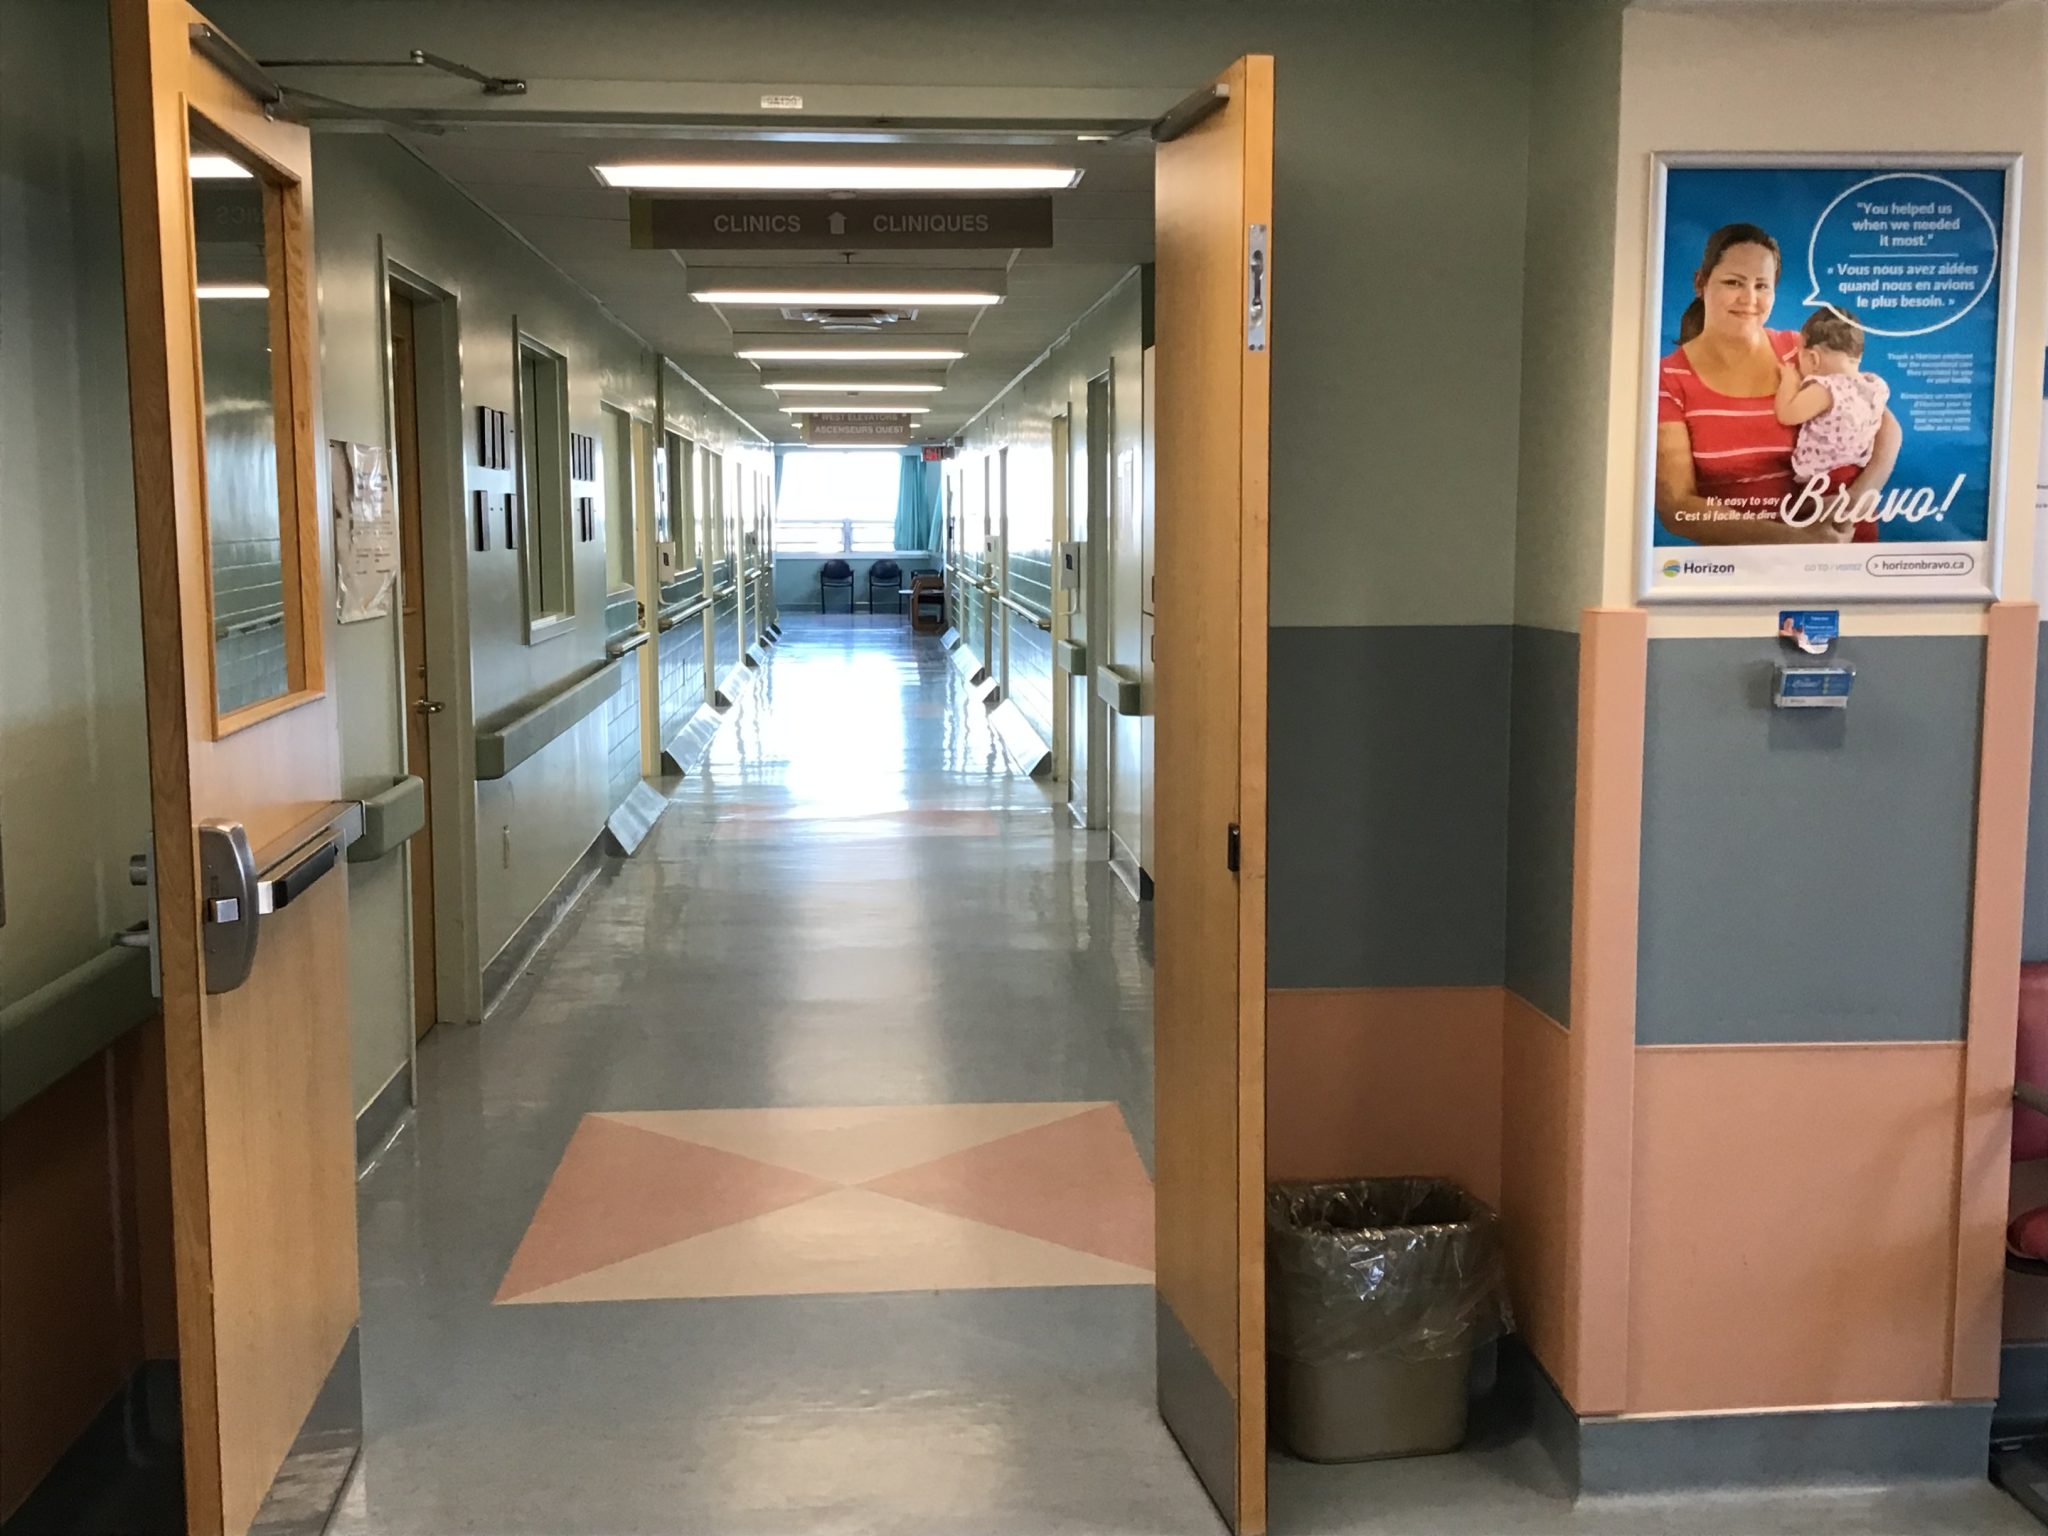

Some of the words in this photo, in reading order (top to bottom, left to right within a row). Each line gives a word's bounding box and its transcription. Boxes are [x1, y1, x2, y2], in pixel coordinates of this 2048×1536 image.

[1891, 202, 1935, 217] helped
[1937, 205, 1953, 215] us
[713, 214, 801, 233] CLINICS
[873, 214, 989, 233] CLINIQUES
[1852, 218, 1888, 231] when
[1891, 221, 1911, 231] we
[1913, 217, 1961, 231] needed
[1879, 234, 1889, 247] it
[1837, 263, 1870, 276] Vous
[1872, 266, 1904, 276] nous
[1906, 265, 1935, 275] avez
[1937, 262, 1979, 275] aidées
[1838, 279, 1880, 294] quand
[1882, 281, 1913, 291] nous
[1915, 281, 1931, 291] en
[1933, 278, 1975, 291] avions
[1857, 295, 1869, 308] le
[1871, 294, 1898, 310] plus
[1900, 294, 1945, 308] besoin.
[821, 412, 845, 422] WEST
[847, 412, 898, 422] ELEVATORS
[814, 425, 874, 435] ASCENSEURS
[875, 425, 904, 434] OUEST
[1706, 496, 1722, 507] It's
[1724, 497, 1748, 508] easy
[1749, 496, 1761, 506] to
[1763, 497, 1780, 507] say
[1780, 472, 1967, 528] Bravo!
[1674, 510, 1701, 522] C'est
[1702, 510, 1712, 521] si
[1713, 509, 1740, 522] facile
[1742, 509, 1755, 520] de
[1756, 509, 1777, 520] dire
[1683, 562, 1736, 574] Horizon
[1882, 559, 1965, 571] horizonbravo.ca
